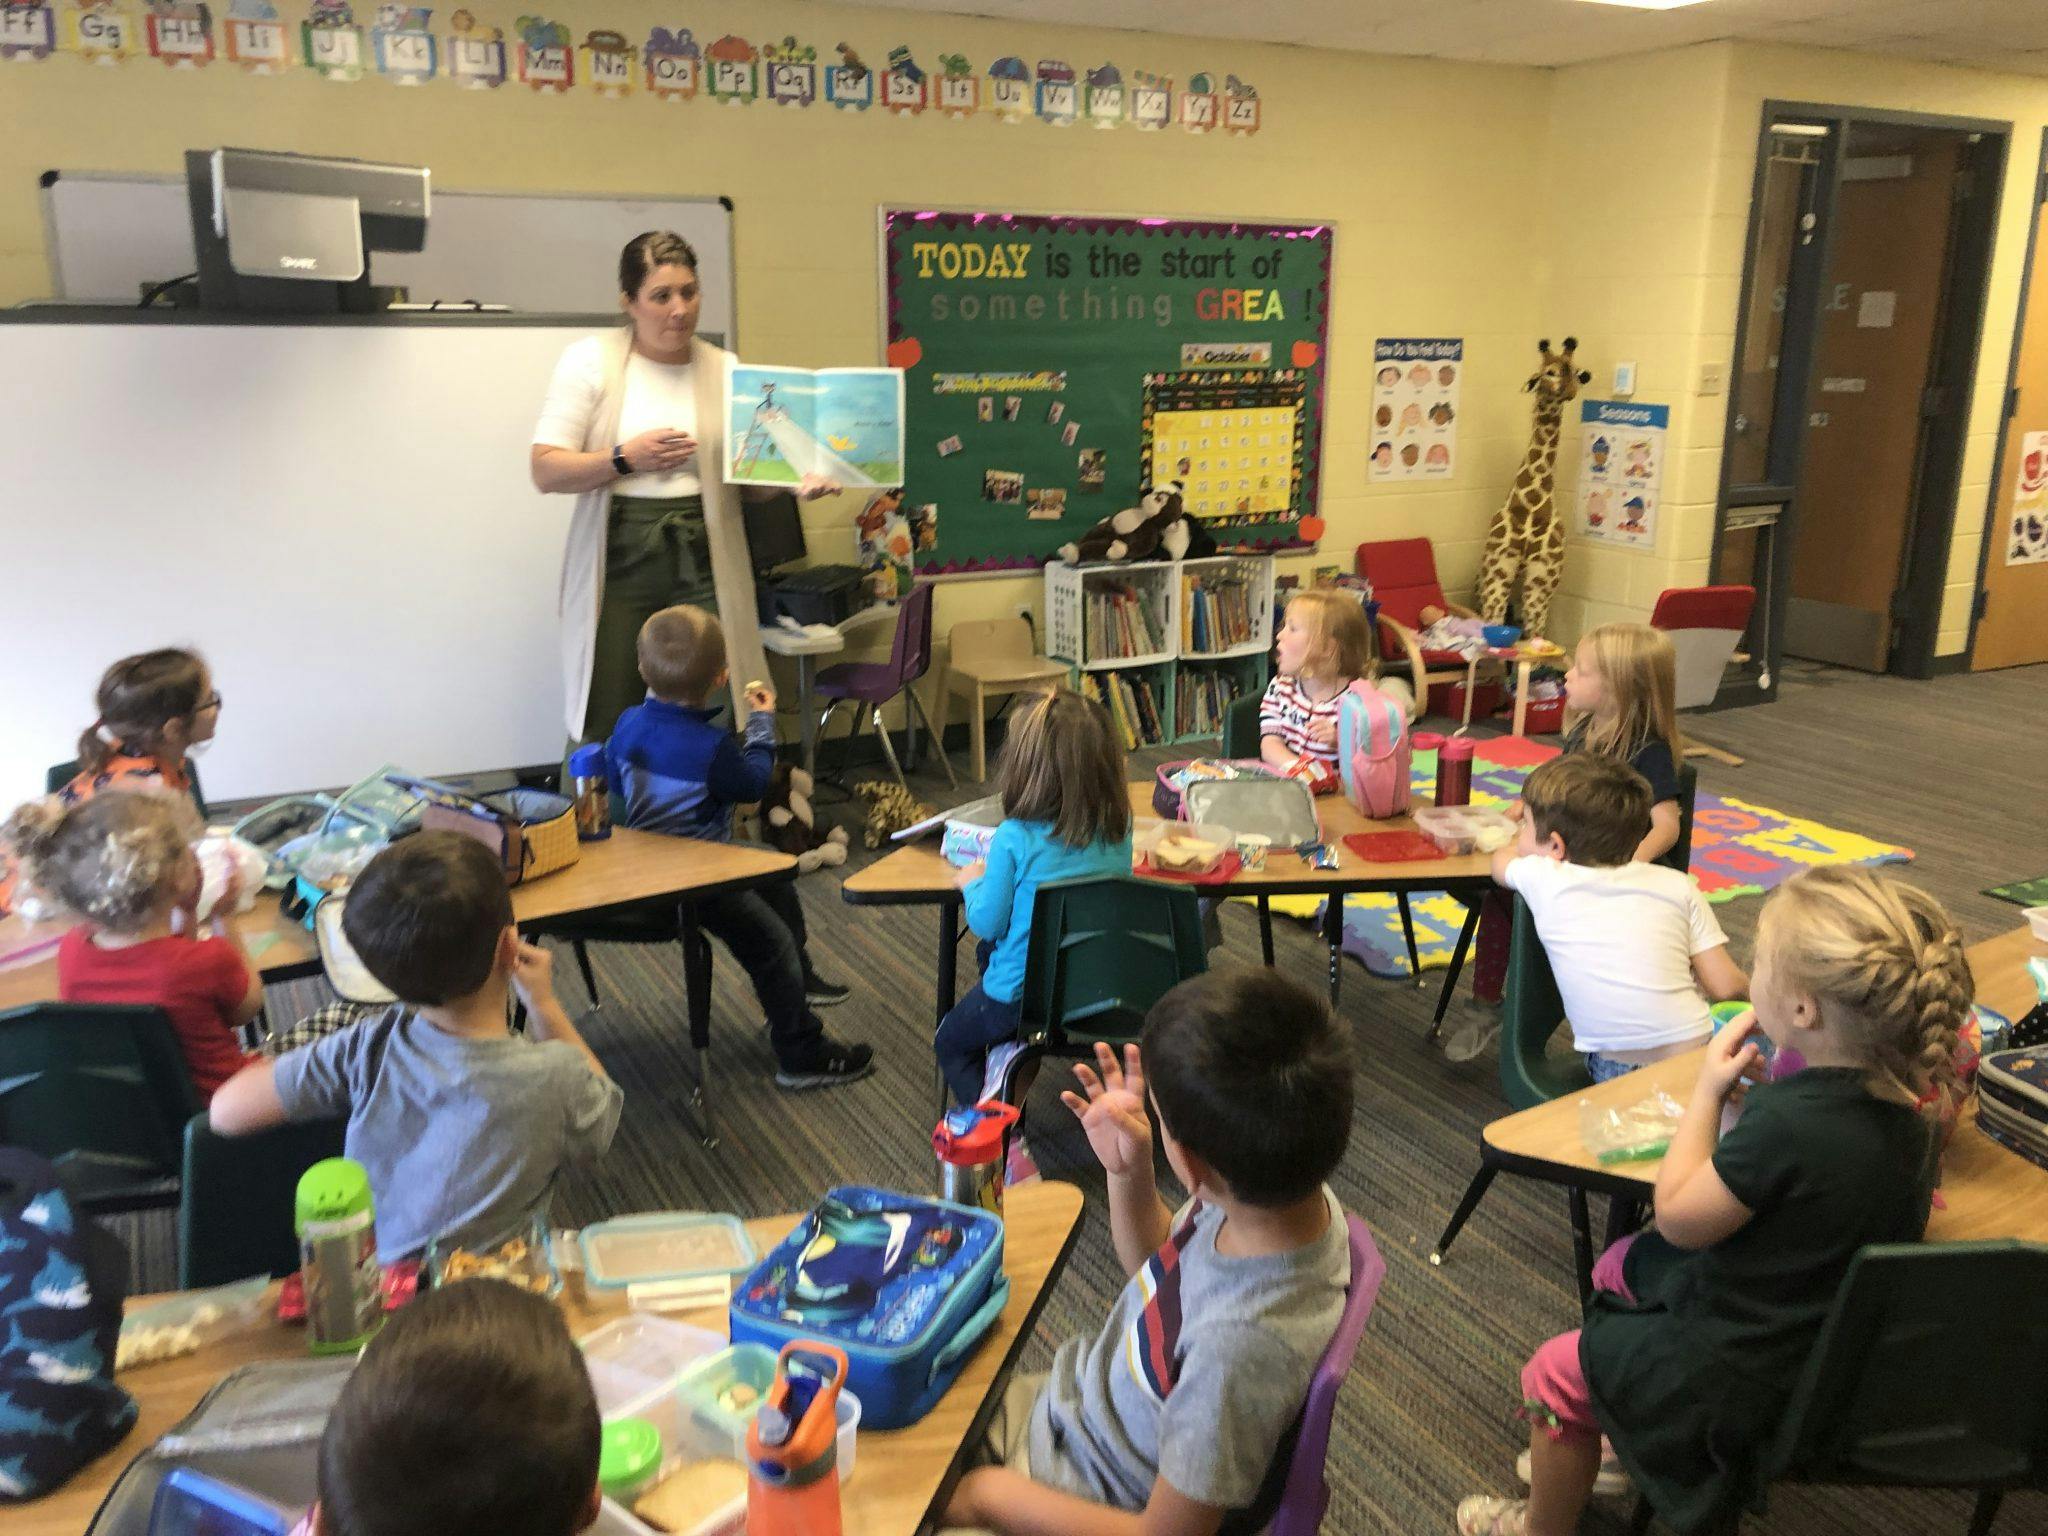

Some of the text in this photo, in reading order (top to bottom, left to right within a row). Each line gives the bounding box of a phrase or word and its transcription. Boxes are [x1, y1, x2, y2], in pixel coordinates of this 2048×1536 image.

[80, 14, 121, 48] Gg
[160, 19, 202, 43] Hh
[526, 50, 566, 71] Mm
[594, 51, 627, 76] Nn
[656, 58, 688, 80] Oo
[719, 62, 745, 91] Pp
[776, 66, 807, 95] Qq
[892, 74, 914, 95] Ss
[950, 79, 968, 98] Tt
[996, 79, 1021, 101] Uu
[1046, 87, 1067, 104] Vv
[1231, 100, 1251, 119] Zz
[913, 242, 1284, 279] TODAY is the start of
[931, 286, 1172, 327] something
[1599, 404, 1652, 423] Seasons
[1766, 834, 1836, 854] A
[1703, 849, 1782, 873] B
